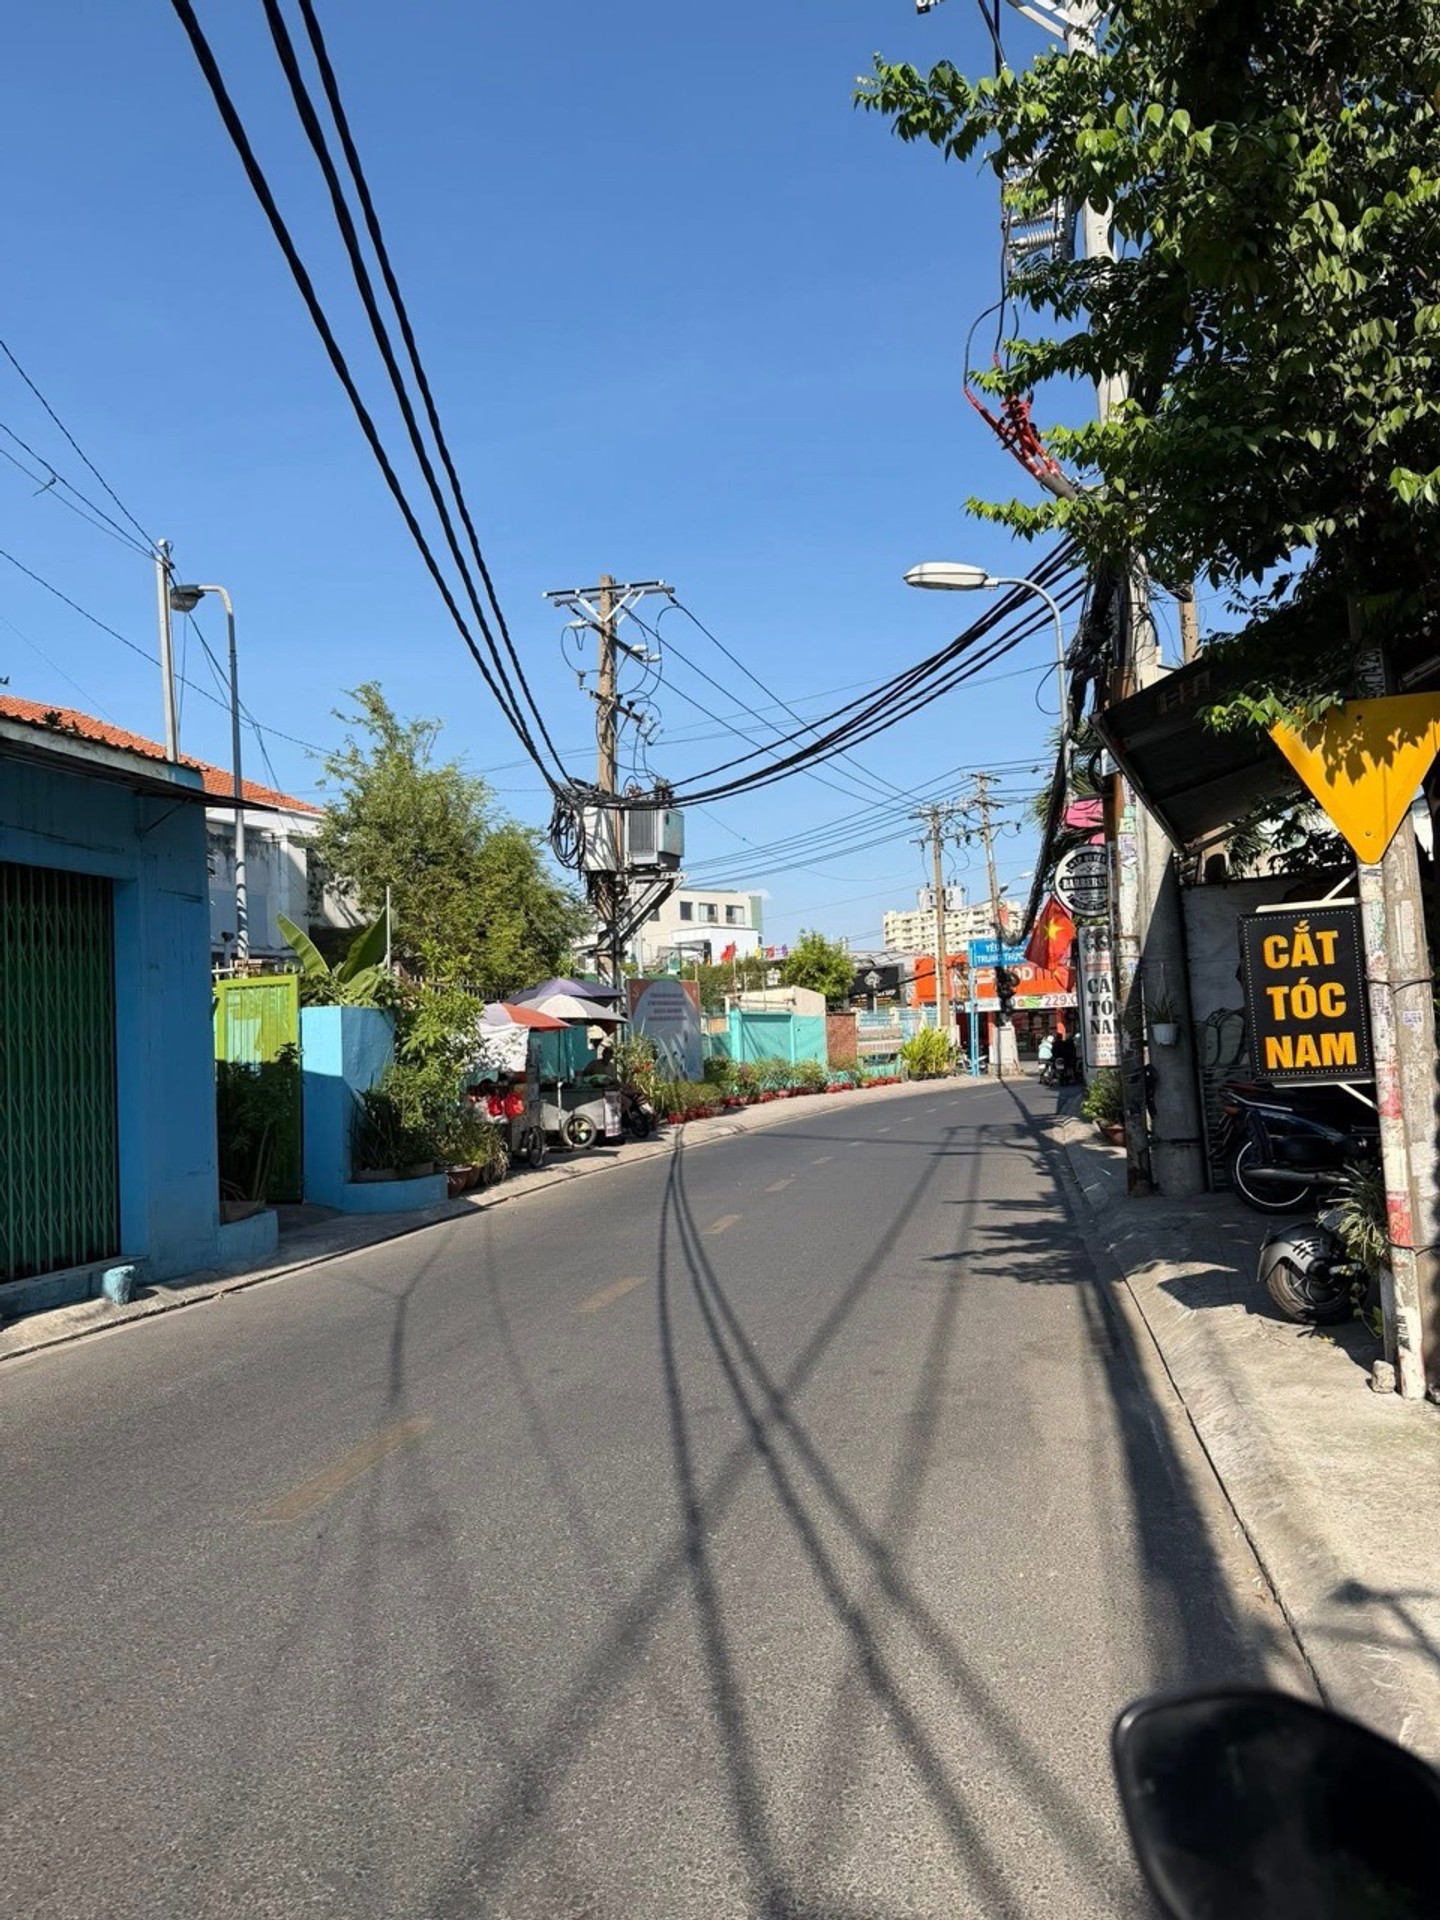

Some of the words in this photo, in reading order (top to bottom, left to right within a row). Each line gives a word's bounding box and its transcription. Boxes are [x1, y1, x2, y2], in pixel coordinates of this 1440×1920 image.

[1263, 920, 1338, 969] CẮT
[1088, 972, 1115, 994] CẮ
[1267, 977, 1346, 1021] TÓC
[1088, 996, 1117, 1016] TÓ
[1265, 1032, 1357, 1069] NAM
